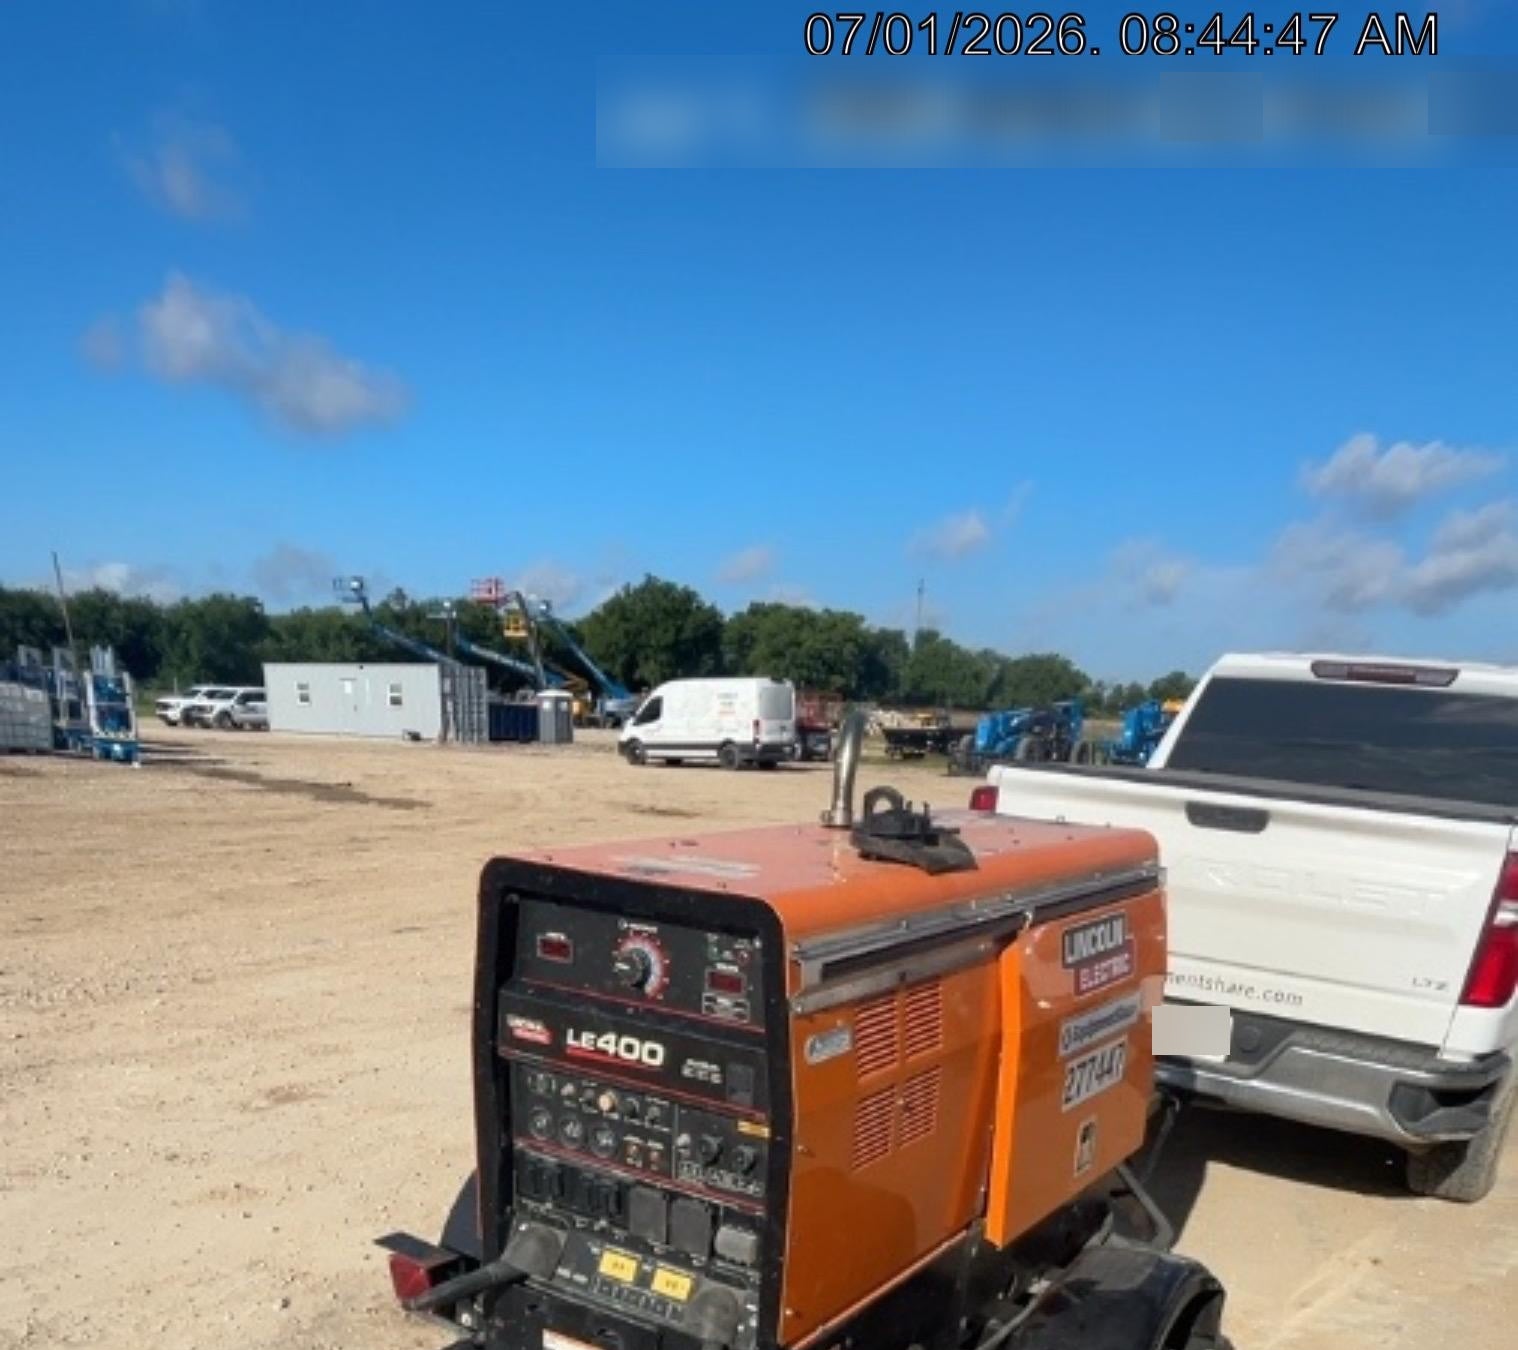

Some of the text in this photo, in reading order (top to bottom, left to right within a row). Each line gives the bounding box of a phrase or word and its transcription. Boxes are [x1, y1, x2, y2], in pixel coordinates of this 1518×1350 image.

[1064, 916, 1124, 965] LINCOLN
[1078, 952, 1131, 992] ELECTRIC
[566, 1028, 665, 1067] LE400
